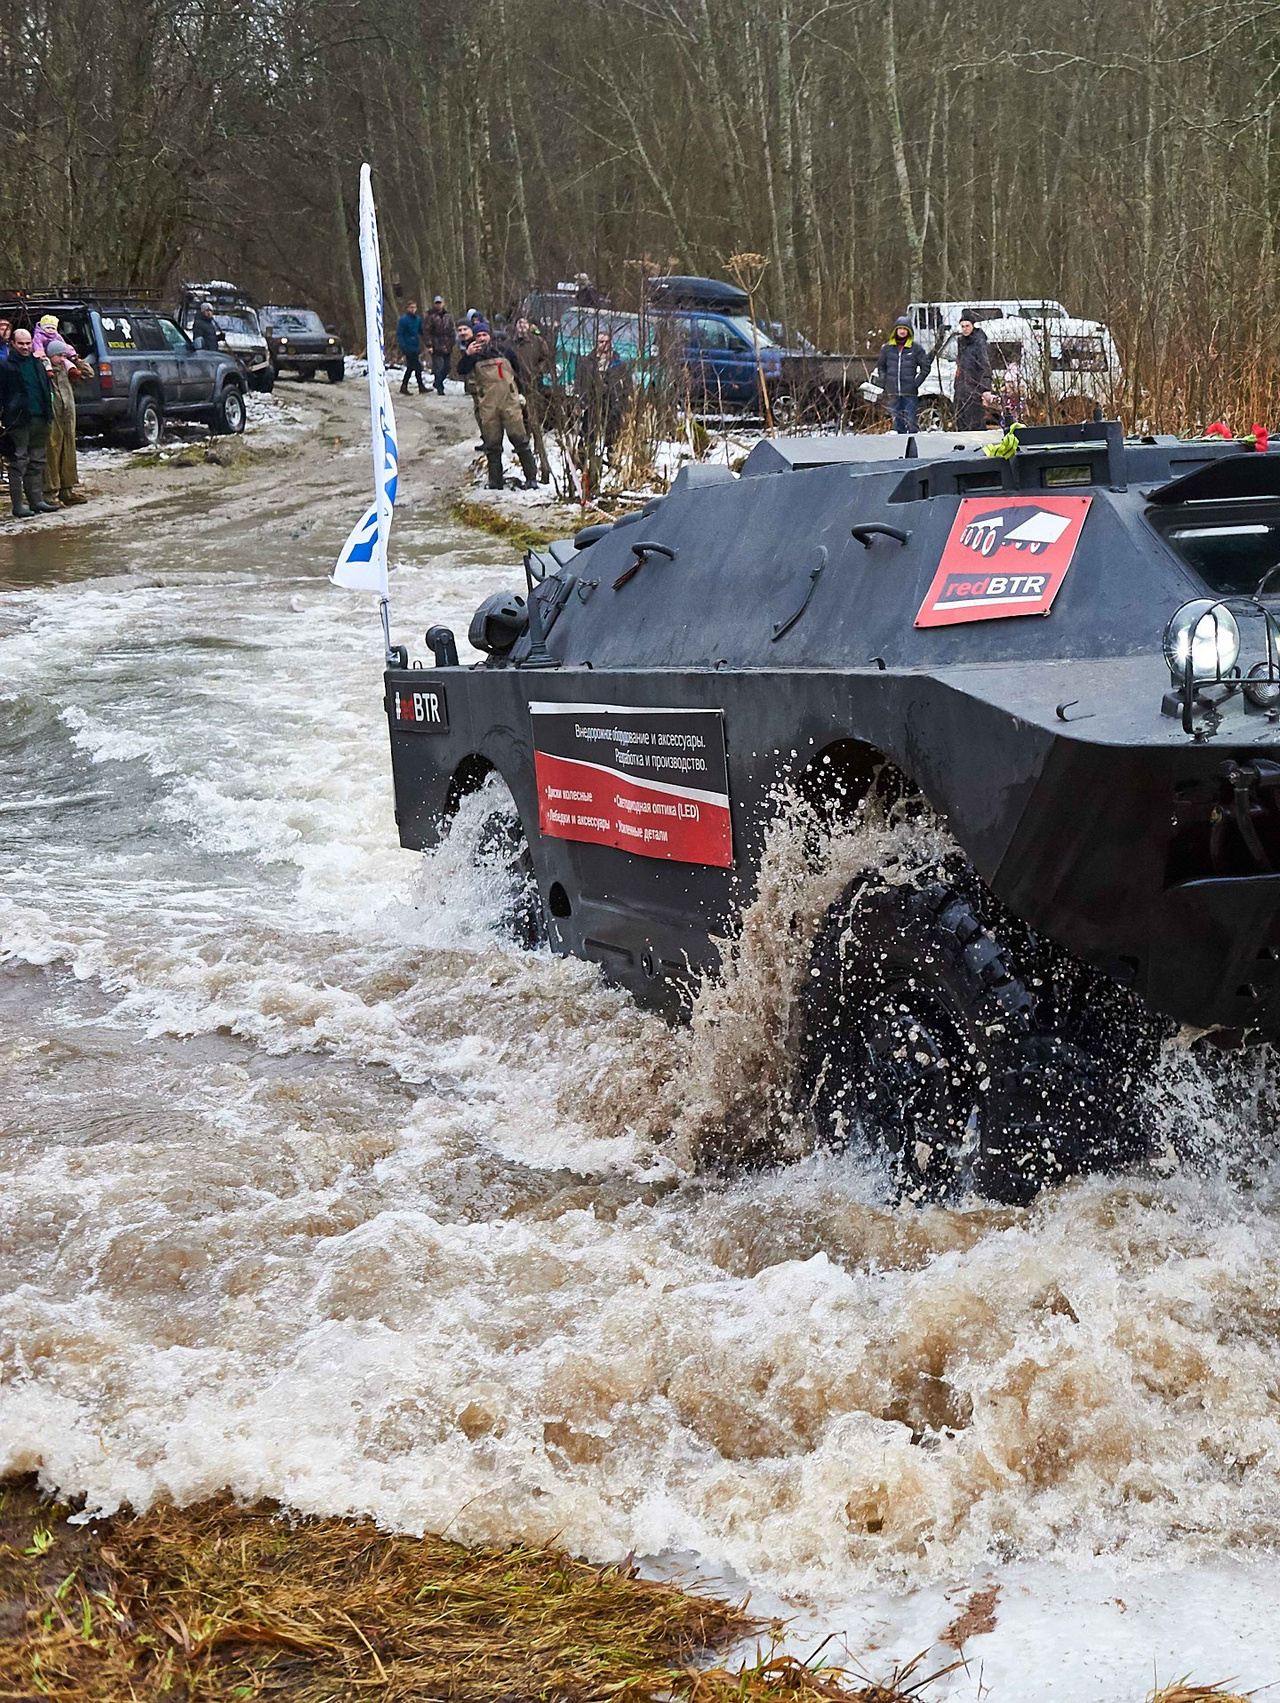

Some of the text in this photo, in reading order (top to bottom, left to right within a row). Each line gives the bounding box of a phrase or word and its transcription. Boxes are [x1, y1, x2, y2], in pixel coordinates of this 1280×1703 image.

[945, 575, 1046, 598] redBTR
[651, 733, 657, 745] и
[657, 733, 706, 752] аксессуары.
[645, 755, 651, 767] и
[651, 754, 708, 774] производство.
[563, 789, 593, 802] колесные
[652, 803, 677, 817] оптика
[678, 802, 700, 822] (LED)
[571, 814, 577, 825] и
[577, 815, 611, 832] аксессуары
[644, 828, 669, 843] детали
